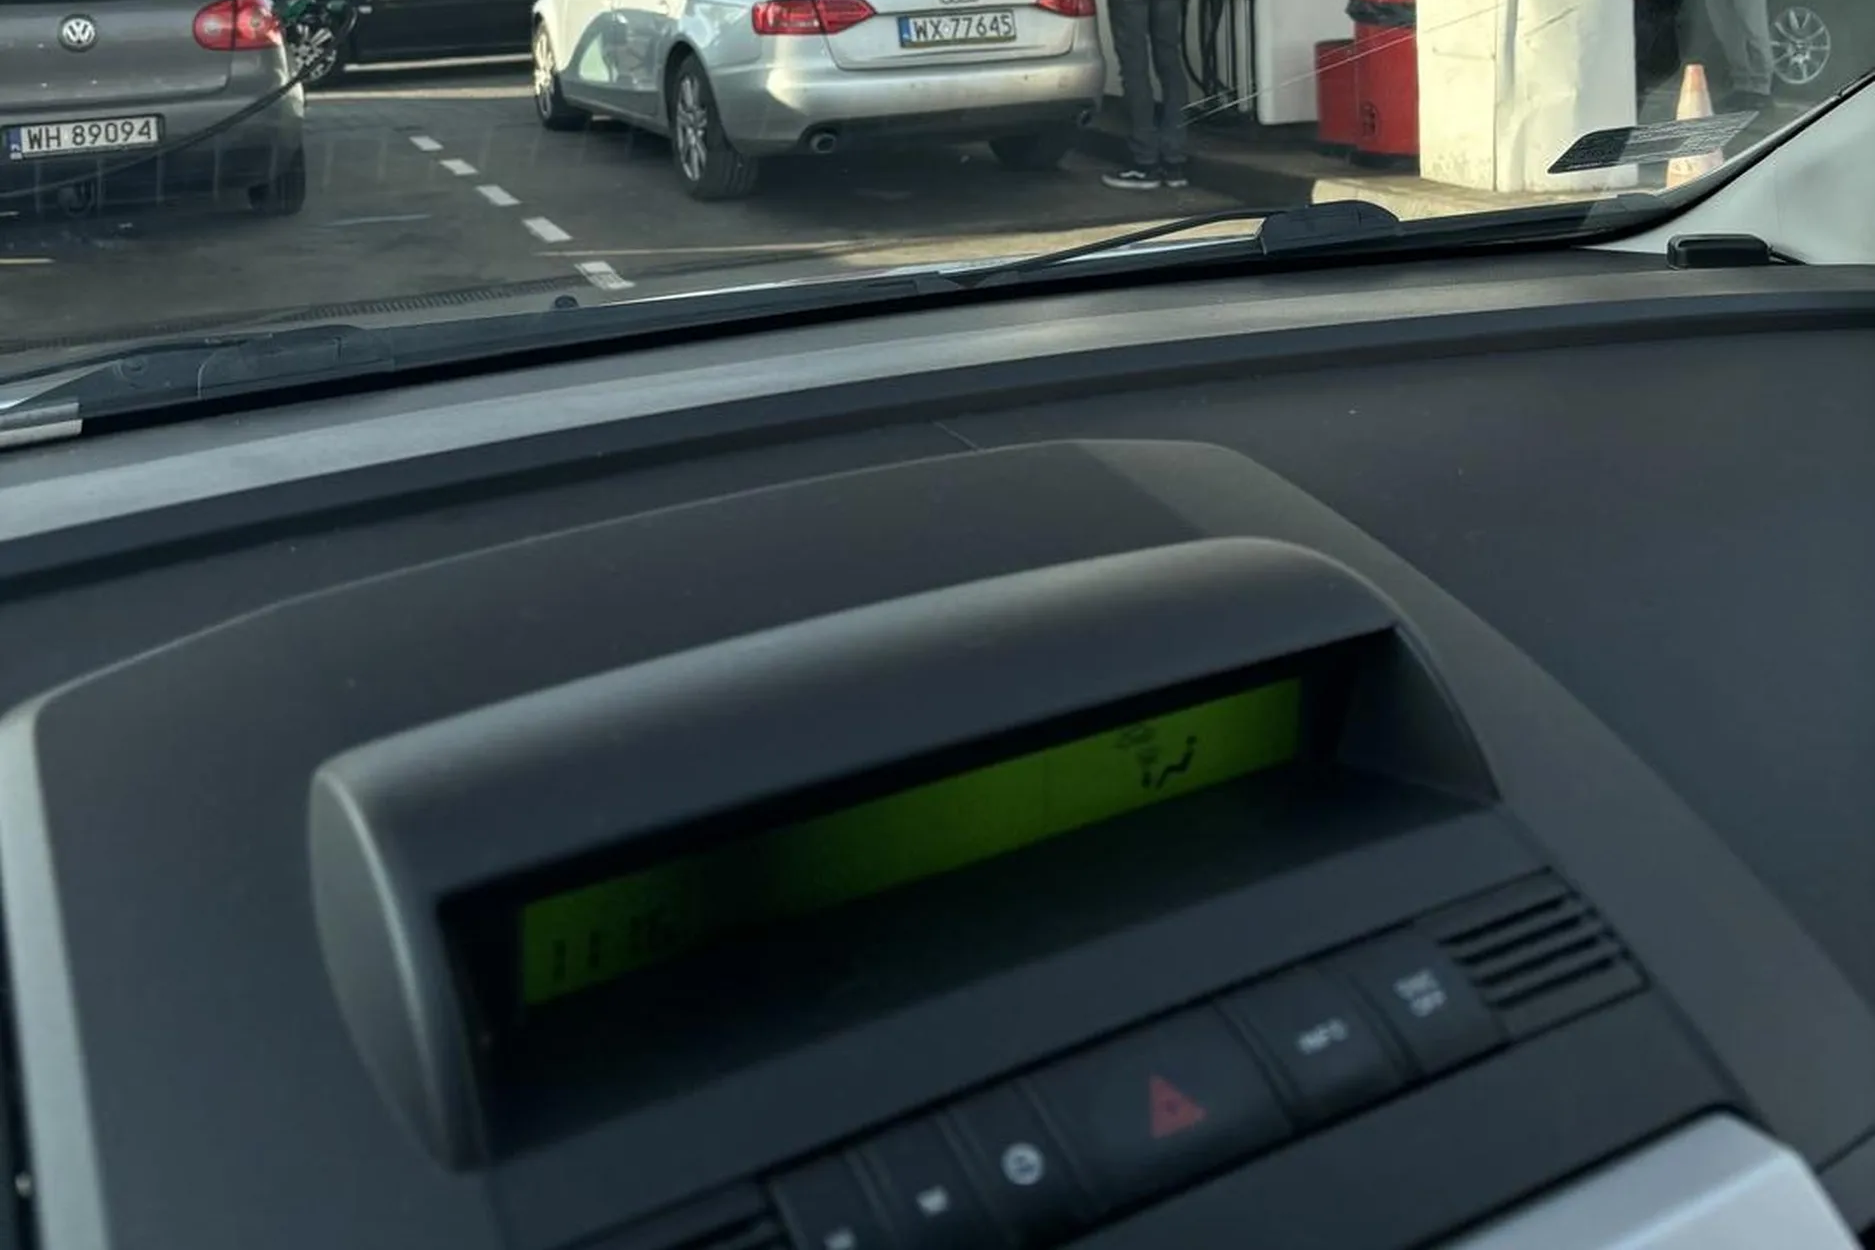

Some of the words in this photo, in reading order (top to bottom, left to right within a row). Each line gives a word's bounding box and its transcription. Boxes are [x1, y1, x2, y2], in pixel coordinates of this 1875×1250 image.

[914, 20, 944, 40] WX
[951, 13, 1012, 39] 77645
[27, 126, 61, 150] WH
[71, 120, 152, 146] 89094
